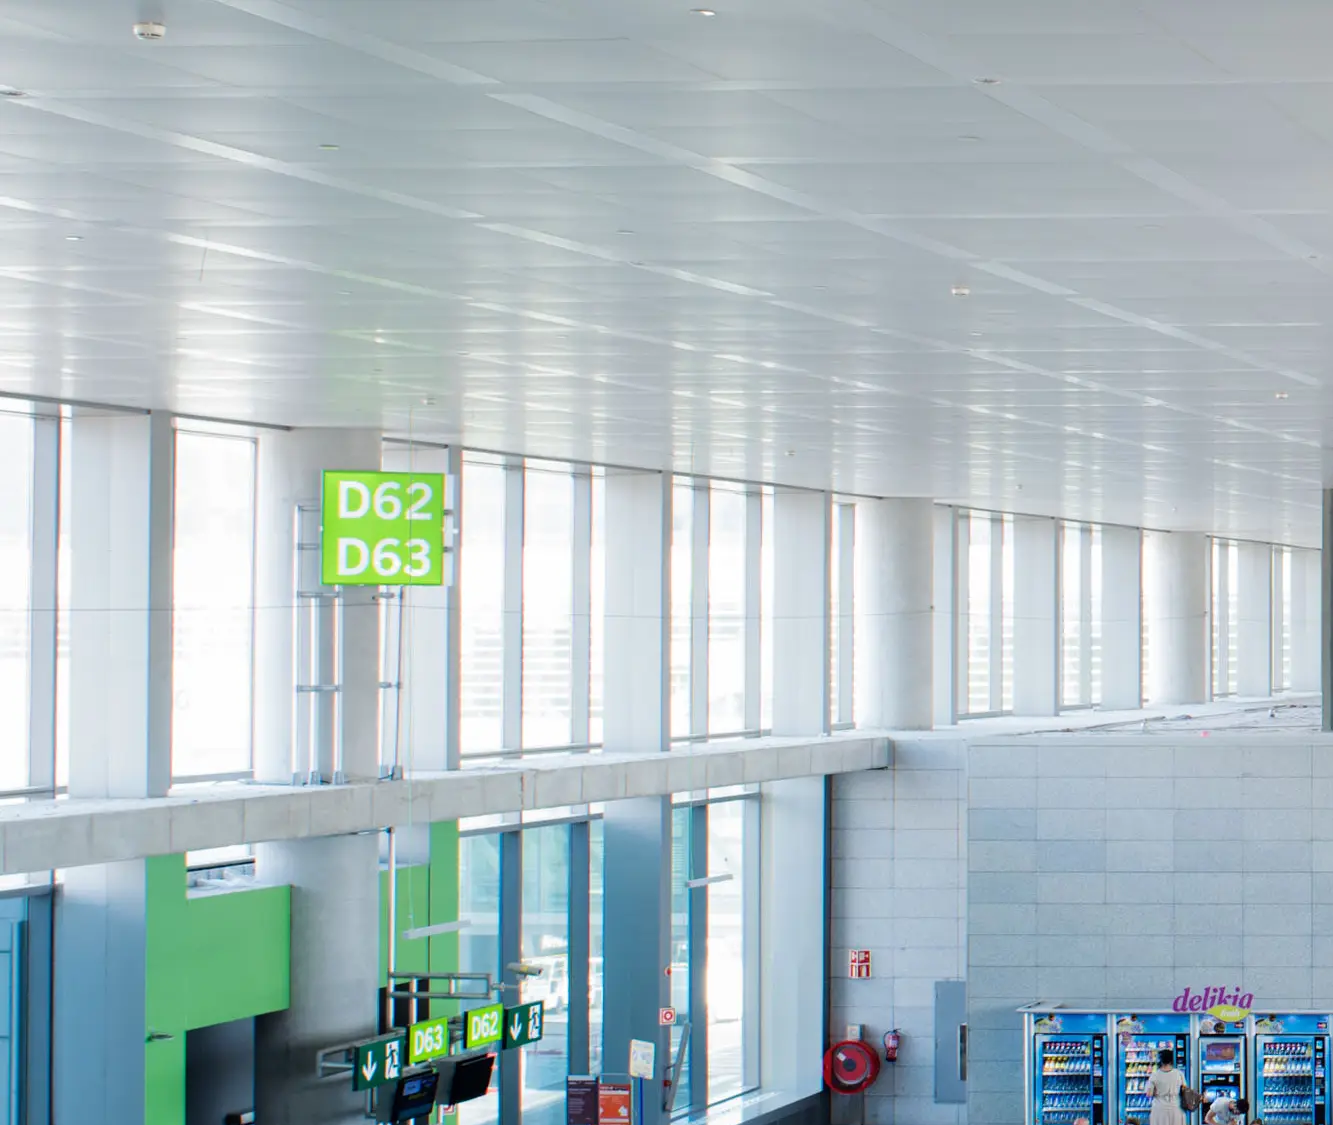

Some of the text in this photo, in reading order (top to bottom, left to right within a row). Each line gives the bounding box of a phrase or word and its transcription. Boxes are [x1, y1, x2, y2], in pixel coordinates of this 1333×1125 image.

[338, 480, 434, 521] D62
[336, 536, 432, 578] D63
[1173, 986, 1254, 1012] delikia
[414, 1024, 444, 1056] D63
[471, 1011, 499, 1041] D62
